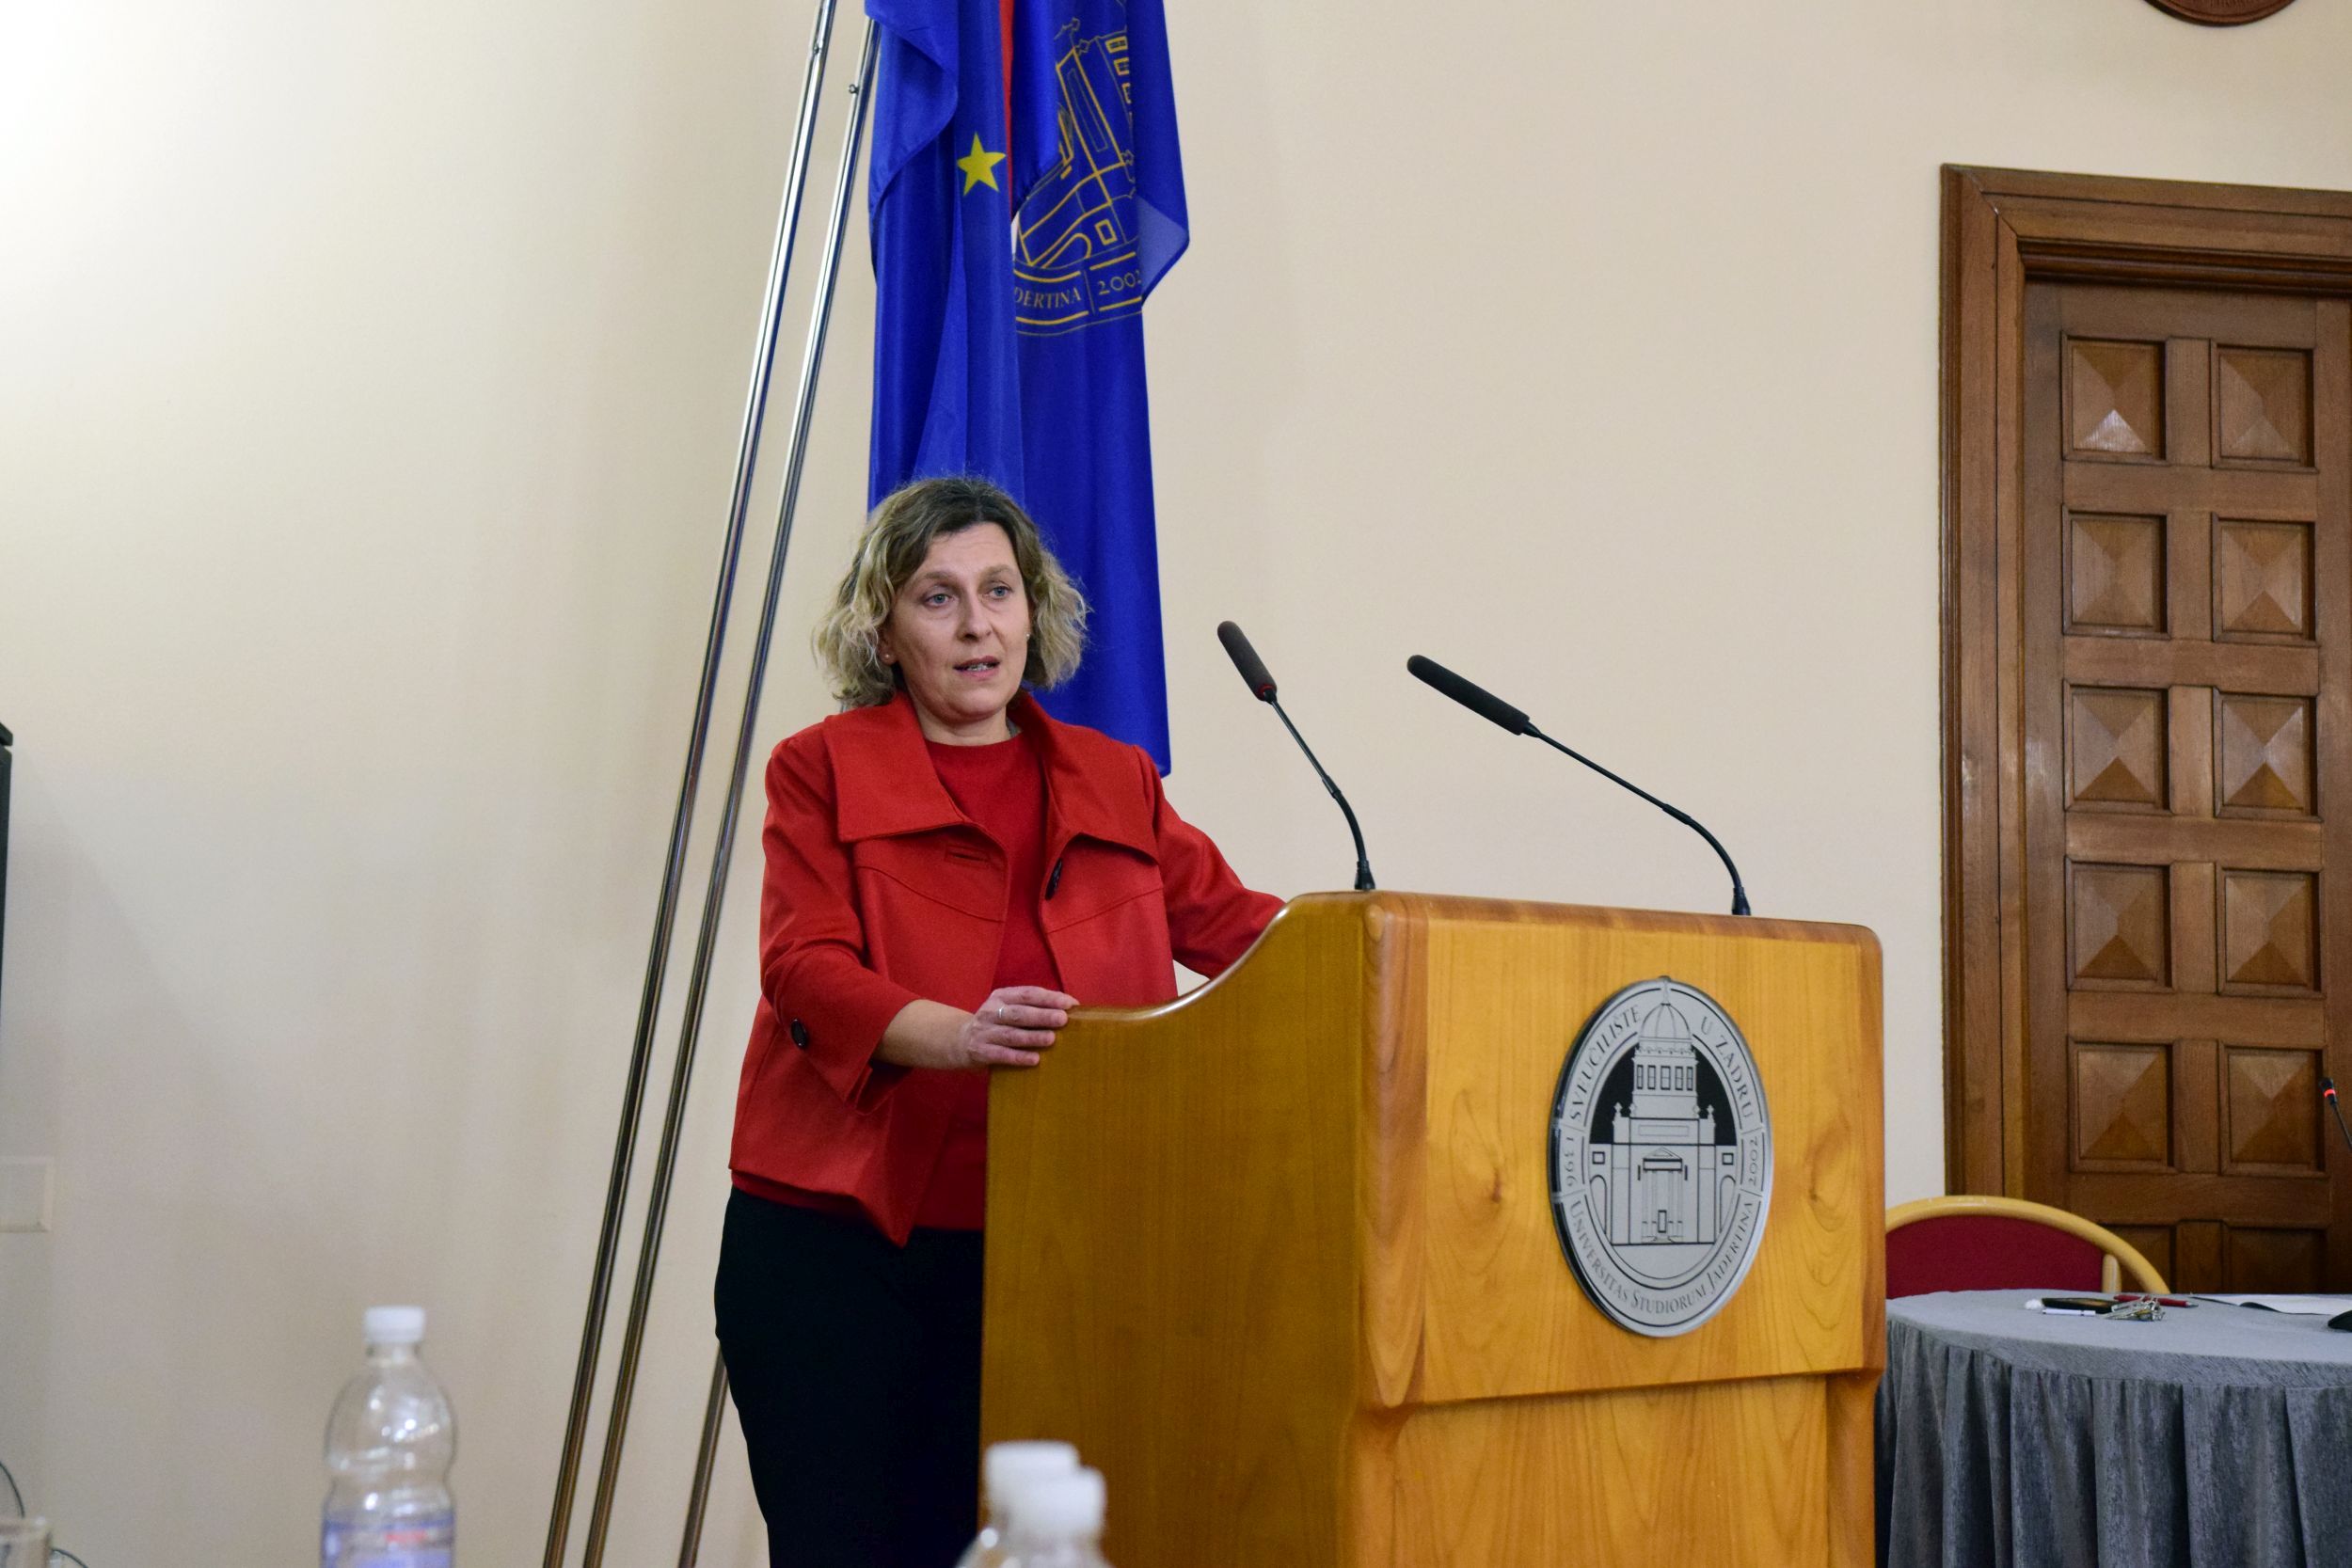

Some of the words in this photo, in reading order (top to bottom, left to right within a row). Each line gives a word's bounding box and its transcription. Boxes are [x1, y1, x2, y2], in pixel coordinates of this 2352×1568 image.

[1014, 285, 1082, 309] DERTINA
[1701, 1015, 1713, 1036] U
[1715, 1034, 1754, 1118] ZADRU
[1564, 1136, 1578, 1187] 1396
[1748, 1135, 1758, 1186] 2002
